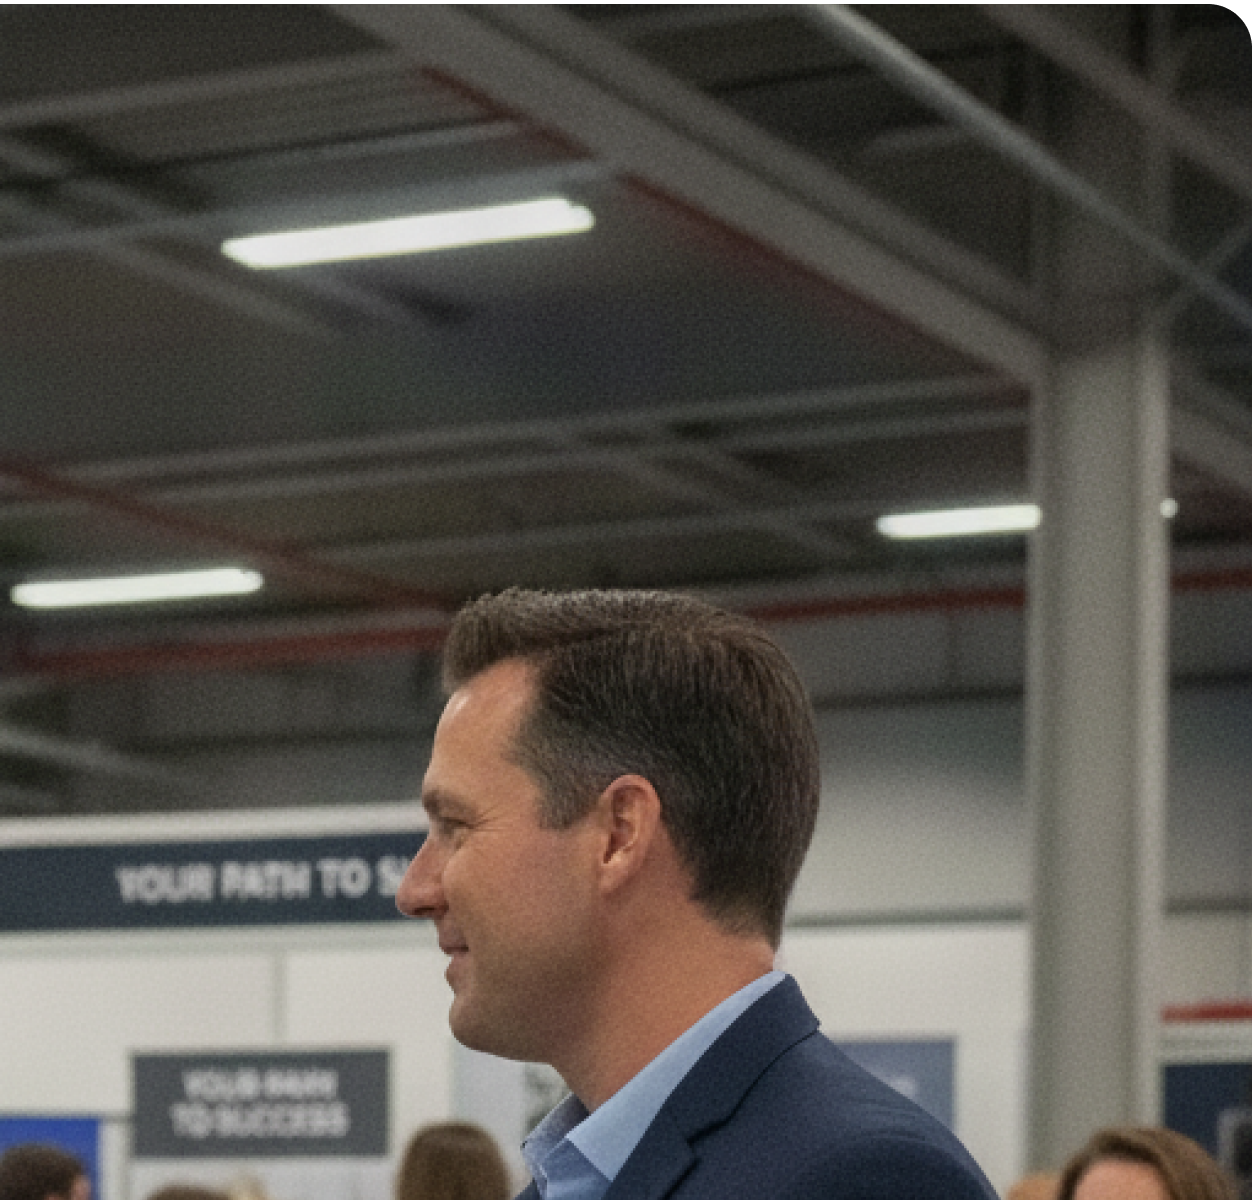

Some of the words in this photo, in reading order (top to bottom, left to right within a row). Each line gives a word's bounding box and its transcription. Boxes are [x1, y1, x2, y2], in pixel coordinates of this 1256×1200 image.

[116, 863, 216, 903] YOUR
[220, 860, 311, 899] PATH
[317, 857, 372, 897] TO
[377, 856, 410, 896] S
